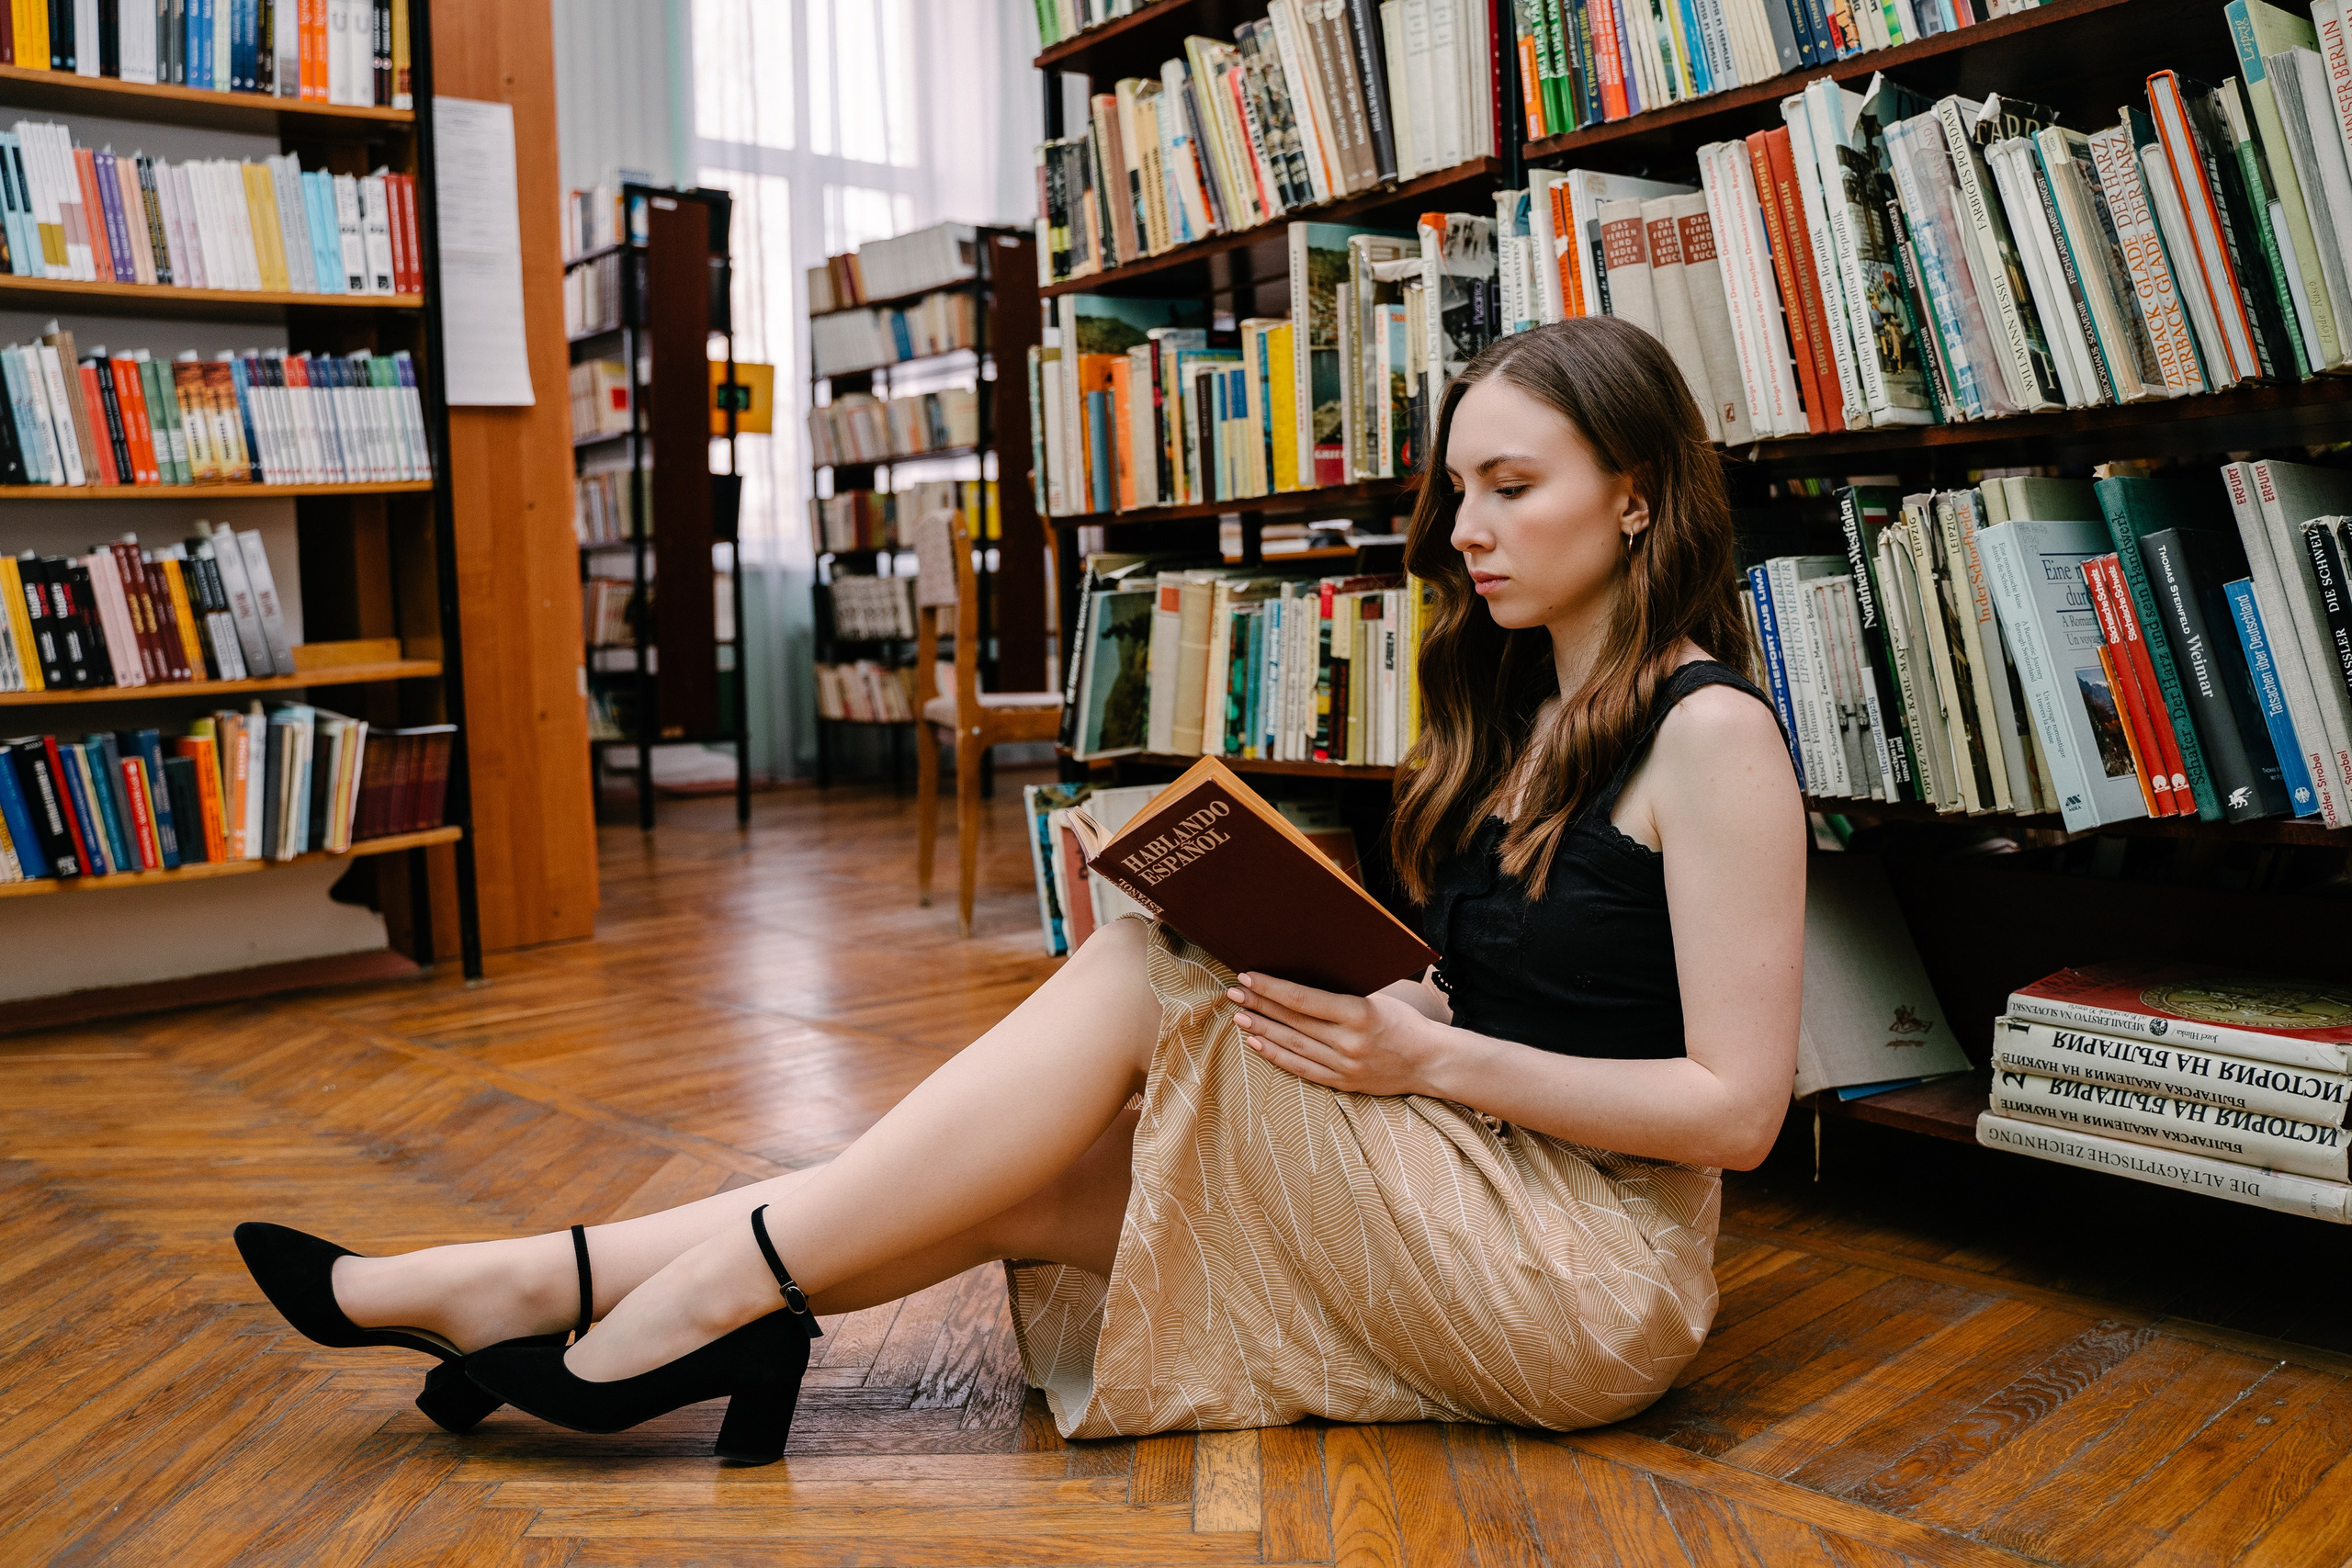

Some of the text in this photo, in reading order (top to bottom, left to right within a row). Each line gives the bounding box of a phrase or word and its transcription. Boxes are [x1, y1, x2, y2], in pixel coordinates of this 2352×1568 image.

[2234, 17, 2256, 62] Leipzig
[2322, 19, 2350, 80] BERLIN
[1705, 155, 1715, 190] Republik
[1727, 154, 1739, 190] Republik
[1943, 108, 1987, 231] FARBIGES POTSDAM
[1607, 229, 1637, 241] FERIEN
[1611, 221, 1628, 231] DAS
[1612, 238, 1632, 248] UND
[1690, 212, 1708, 225] DAS
[1692, 232, 1712, 243] UND
[1710, 191, 1729, 256] Demokratischen
[1732, 190, 1753, 255] Demokratischen
[1754, 150, 1804, 341] DEUTSCHE DEMOKRATISCHE REPUBLIK
[1612, 255, 1636, 266] BUCH
[1814, 228, 1830, 276] Republik
[1888, 208, 1916, 288] DRESDNER ZWINGER
[2092, 139, 2183, 391] ZERBACK GLADE DER HARZ
[2112, 132, 2202, 387] ZERBACK GLADE DER HARZ
[1724, 257, 1737, 299] Deutschen
[1746, 256, 1760, 299] Deutschen
[1780, 181, 1828, 376] DEUTSCHE DEMOKRATISCHE REPUBLIK
[1833, 209, 1878, 400] Deutsche Demokratische Republik
[1758, 313, 1767, 329] aus
[1822, 276, 1848, 362] Demokratische
[2309, 280, 2332, 344] Heyde Rusch
[1738, 330, 1753, 386] Impressionen
[1761, 330, 1777, 387] Impressionen
[1921, 327, 1937, 367] SOUVENIR
[2006, 320, 2034, 391] WILLMANN
[2076, 302, 2113, 399] BROCKHAUS SOUVENIR
[1746, 387, 1758, 417] Farbige
[1770, 387, 1782, 417] Farbige
[2227, 468, 2247, 505] ERFURT
[2255, 465, 2276, 502] ERFURT
[1909, 516, 1923, 558] LEIPZIG
[1945, 513, 1960, 554] LEIPZIG
[2111, 510, 2144, 587] Handwerk
[1840, 499, 1877, 629] Nordrhein-Westfalen
[1957, 502, 1992, 624] In der Schorfheide
[1991, 545, 2001, 564] durch
[1999, 570, 2011, 597] Schweiz
[1998, 542, 2022, 610] Eine romantische Reise
[2041, 559, 2072, 581] Eine
[2308, 527, 2340, 613] DIE SCHWEIZ
[1754, 569, 1772, 632] AUS LIMA
[1804, 589, 1814, 621] Bodden
[2062, 615, 2069, 627] A
[2091, 569, 2120, 644] Sächsische Schweiz
[2109, 565, 2138, 642] Sächsische Schweiz
[2137, 587, 2156, 618] sein
[2158, 545, 2214, 698] THOMAS STEINFELD Weimar
[1814, 640, 1822, 659] Meer
[2015, 622, 2038, 682] through Switzerland
[2024, 626, 2036, 655] Romantic
[2030, 654, 2043, 680] Journey
[2066, 634, 2079, 646] Un
[2143, 620, 2165, 648] und
[2234, 594, 2284, 717] Tatsachen über Deutschland
[1770, 561, 1817, 790] Metscher Fellmann LIPSIA UND MERKUR
[1781, 561, 1828, 791] Metscher Fellmann LIPSIA UND MERKUR
[1817, 665, 1828, 695] Zwischen
[2159, 652, 2178, 692] Harz
[2037, 698, 2046, 718] travers
[2045, 723, 2054, 745] Suisse
[2042, 690, 2066, 759] Un voyage romantique
[2170, 693, 2187, 721] Der
[1887, 737, 1902, 783] So schön ist
[1894, 736, 1911, 782] unser Land
[2310, 752, 2339, 828] Schäfer-Strobel
[1121, 801, 1230, 873] HABLANDO
[1138, 828, 1231, 886] ESPAÑOL
[2010, 1001, 2219, 1043] Jozef Hlinka MEDAILÉRSTVO NA SLOVENSKU
[2002, 1052, 2245, 1109] БЪЛГАРСКА АКАДЕМИЯ НА НАУКИТЕ
[2007, 1022, 2344, 1104] ИСТОРИЯ НА БЪЛГАРИЯ 1
[2001, 1099, 2243, 1154] БЪЛГАРСКА АКАДЕМИЯ НА НАУКИТЕ
[2002, 1072, 2338, 1147] ИСТОРИЯ НА БЪЛГАРИЯ 2
[1989, 1128, 2260, 1197] DIE ALTÄGYPTISCHE ZEICHNUNG
